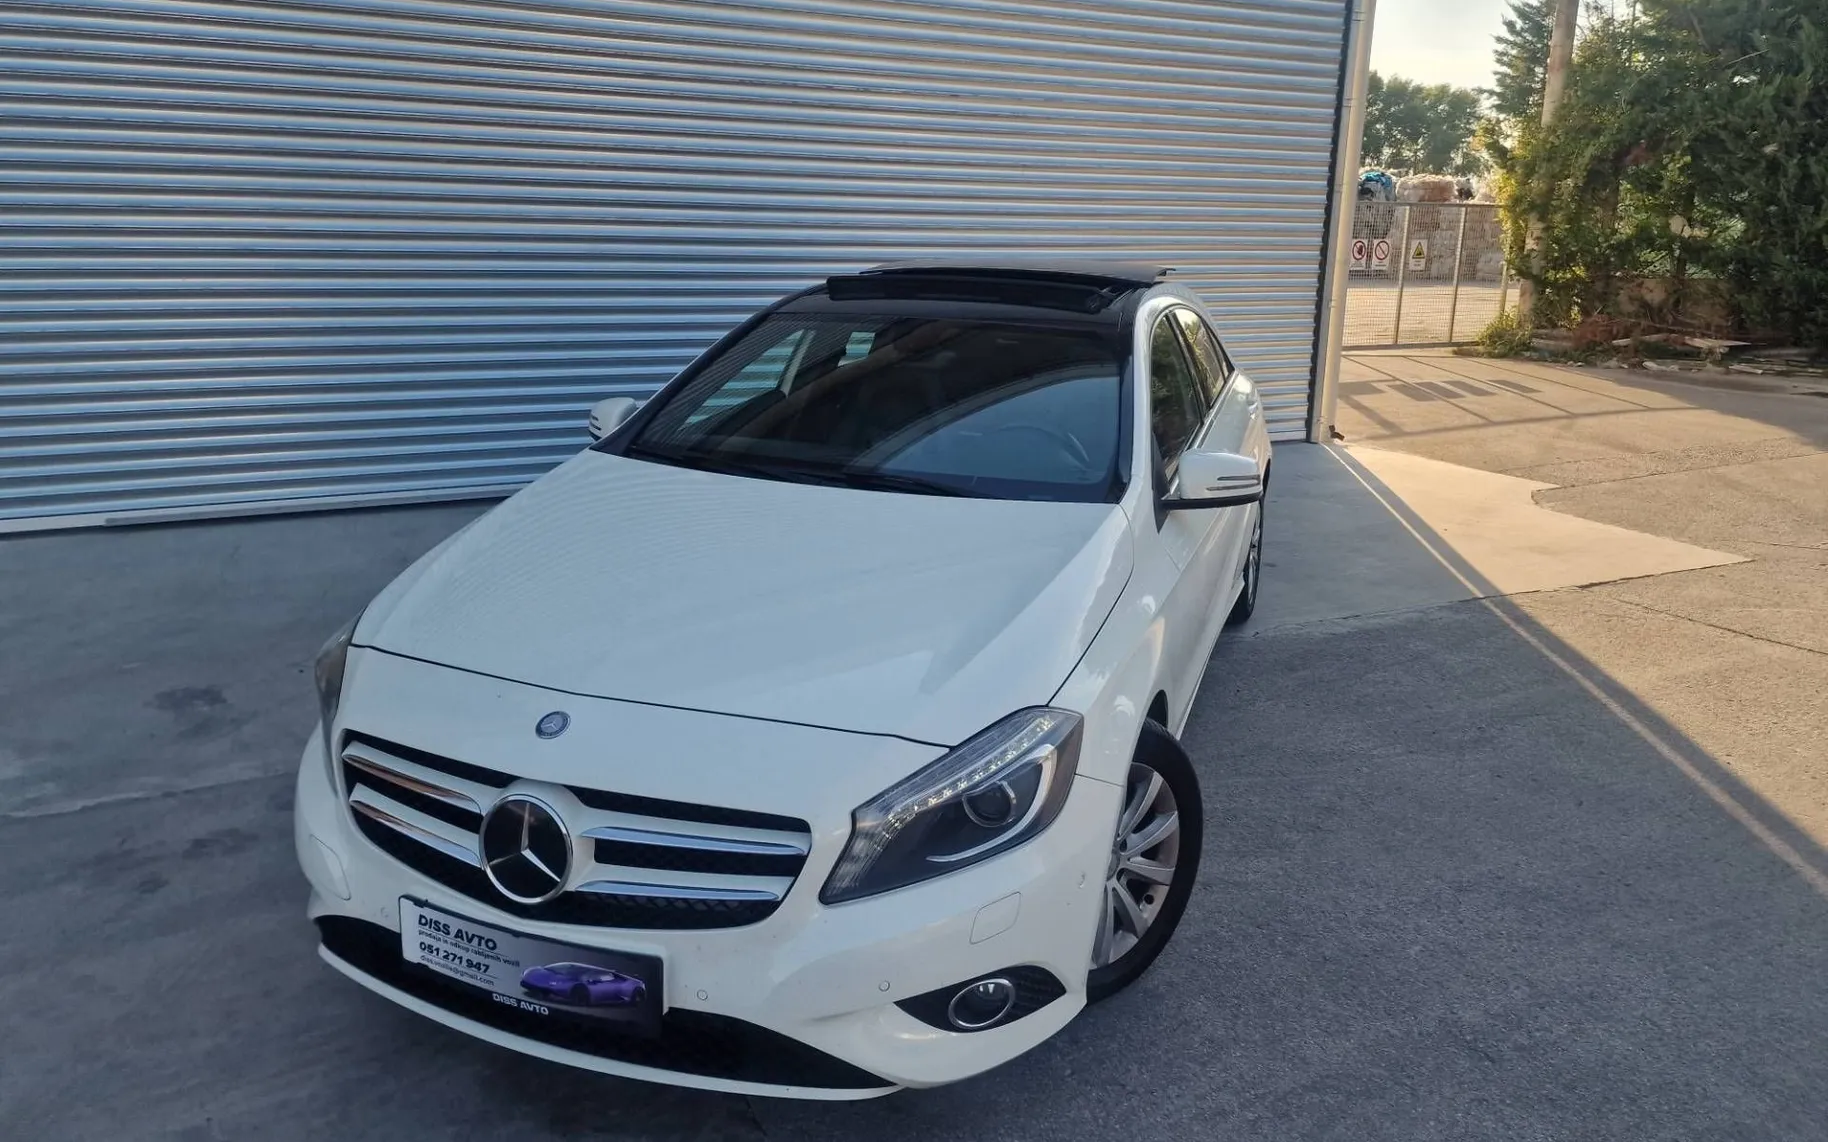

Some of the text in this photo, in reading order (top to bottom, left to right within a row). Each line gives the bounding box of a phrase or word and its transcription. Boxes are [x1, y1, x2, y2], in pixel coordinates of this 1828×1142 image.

[418, 914, 498, 951] DISS AVTO
[419, 941, 490, 974] 051 271 947
[492, 992, 549, 1015] DISS AVTO
